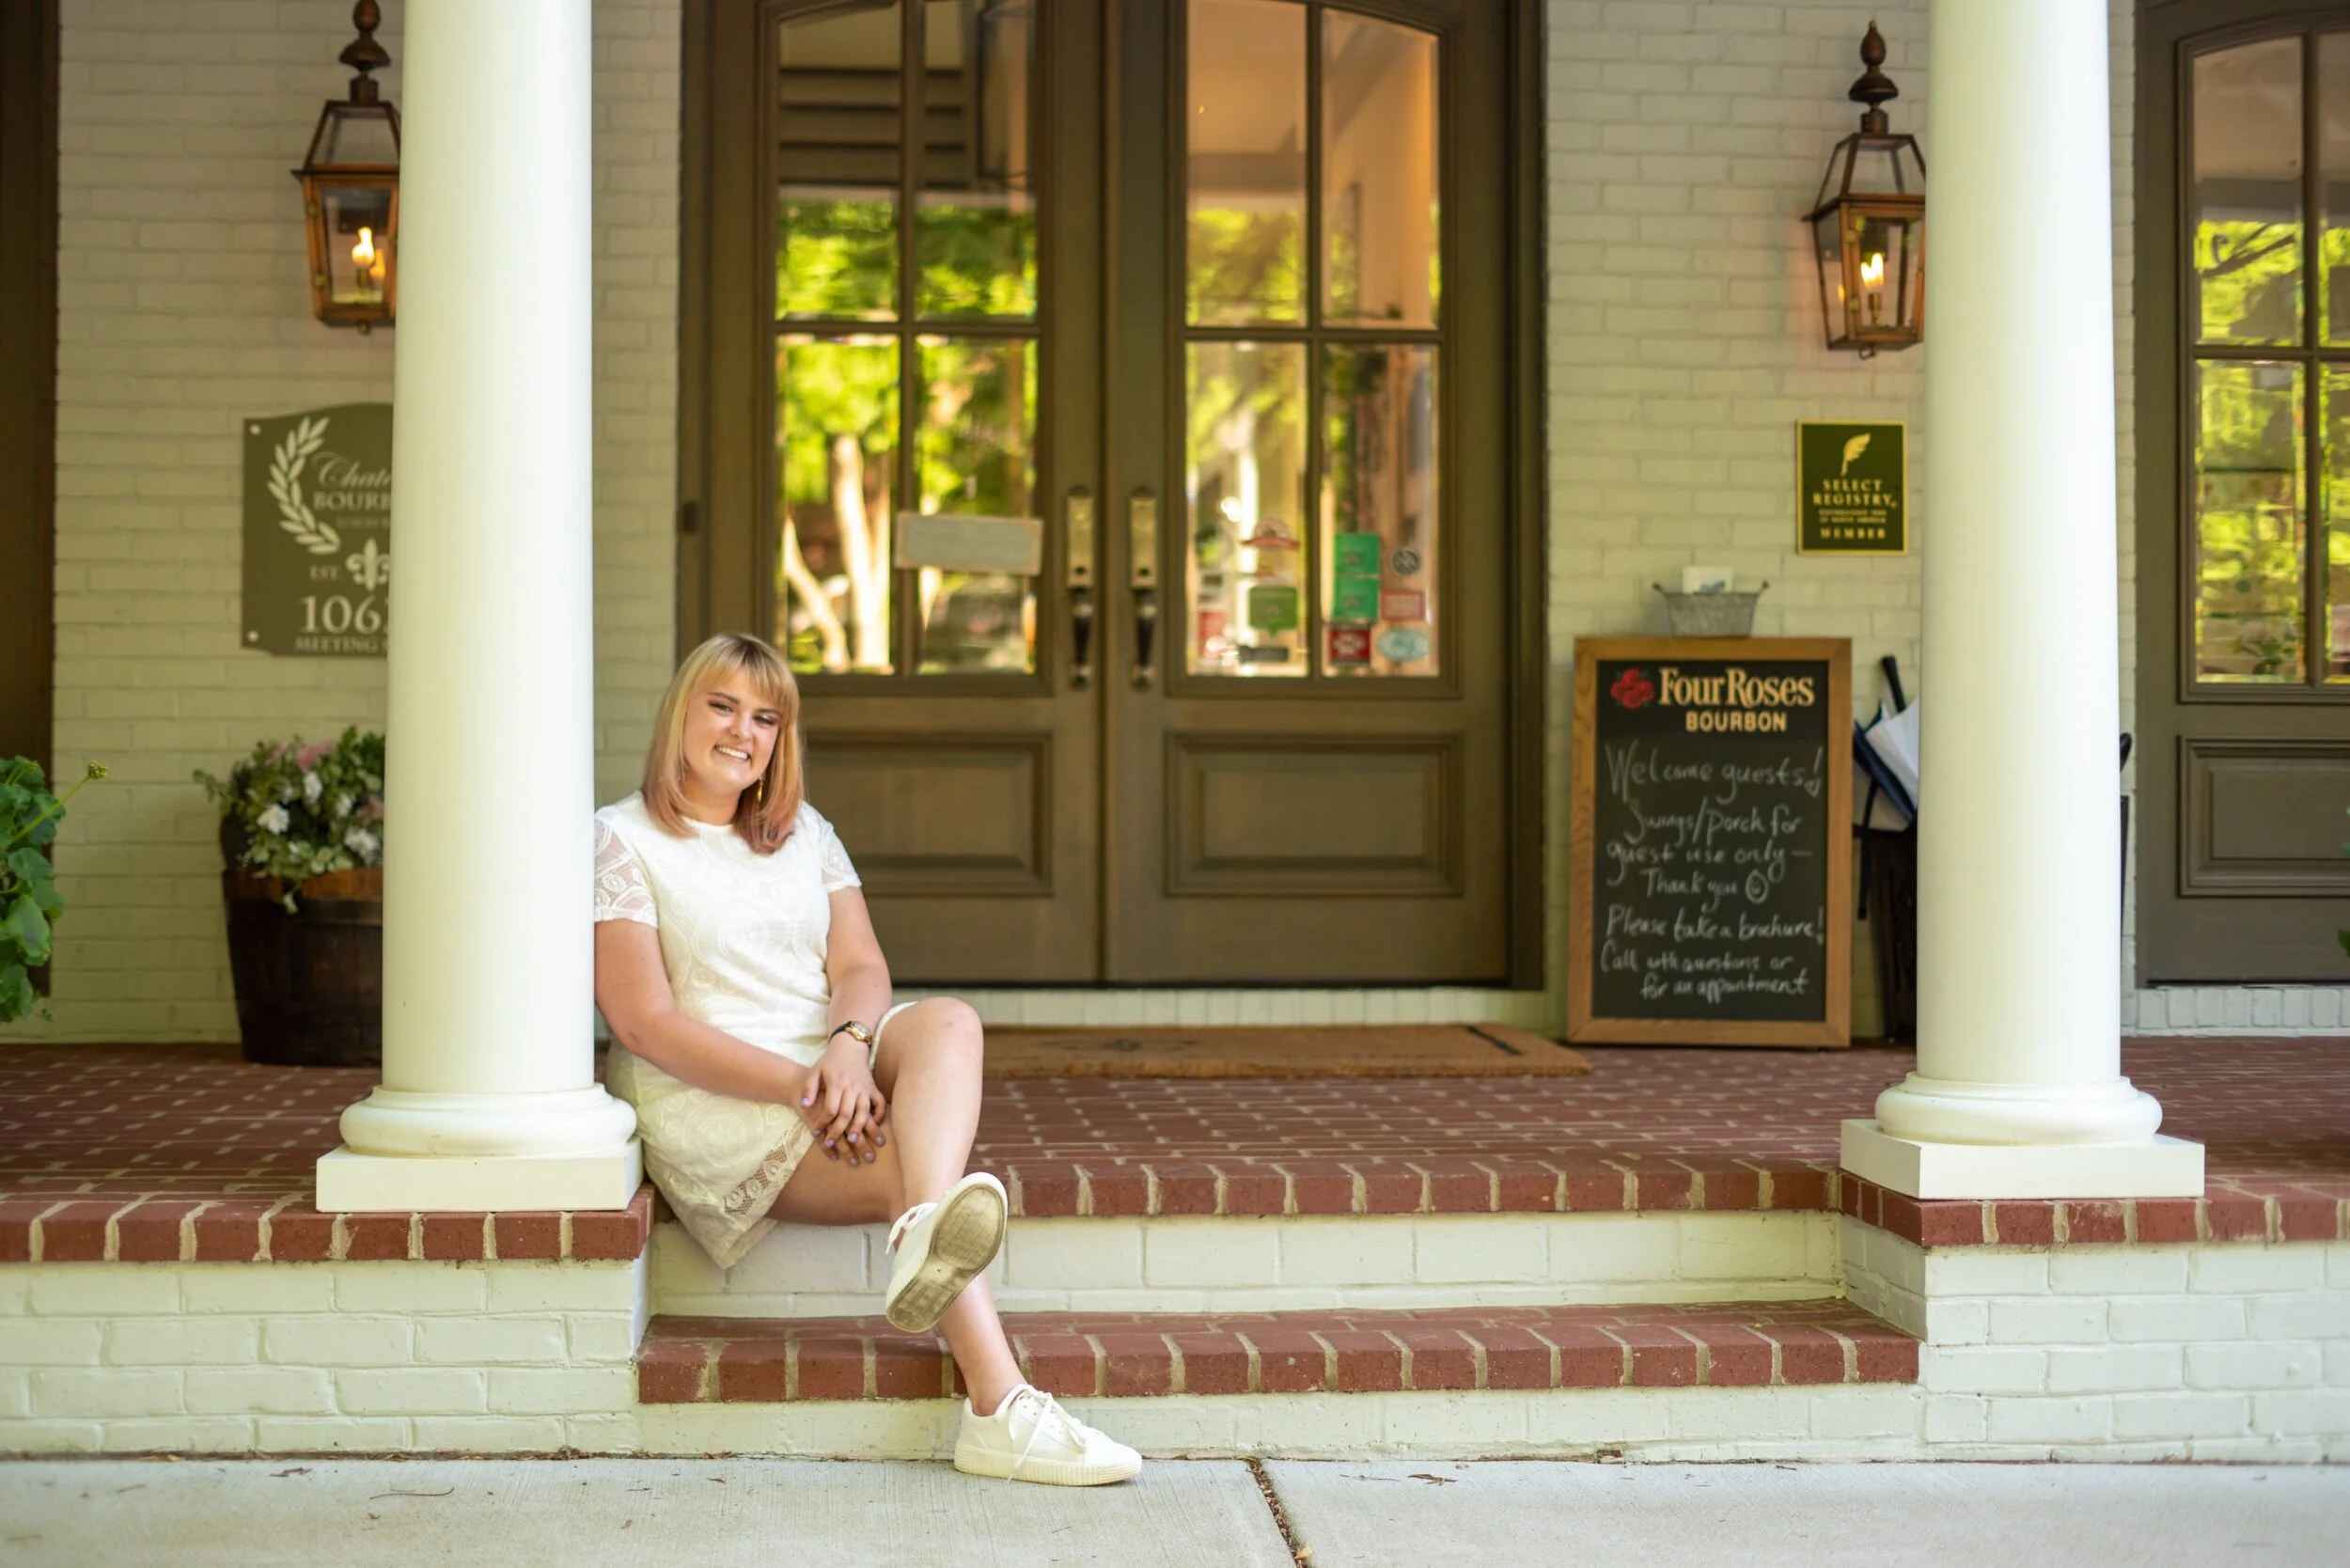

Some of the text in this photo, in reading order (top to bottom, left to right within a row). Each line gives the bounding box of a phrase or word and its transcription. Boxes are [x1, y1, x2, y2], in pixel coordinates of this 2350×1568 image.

[1823, 479, 1882, 492] SELECT
[1820, 527, 1886, 540] MEMBER
[297, 594, 388, 635] 106
[1658, 666, 1815, 709] Four Roses
[1685, 711, 1787, 733] BOURBON
[1605, 739, 1824, 806] Welcome guests!
[1770, 802, 1803, 838] for
[1606, 840, 1674, 886] guest
[1685, 847, 1726, 863] use
[1638, 868, 1738, 914] Thank you
[1606, 902, 1668, 938] Please
[1672, 906, 1719, 944] take
[1719, 923, 1733, 939] a
[1601, 937, 1639, 973] Call
[1646, 949, 1679, 972] with
[1768, 954, 1795, 971] or
[1639, 971, 1669, 1000] for
[1672, 980, 1693, 996] an
